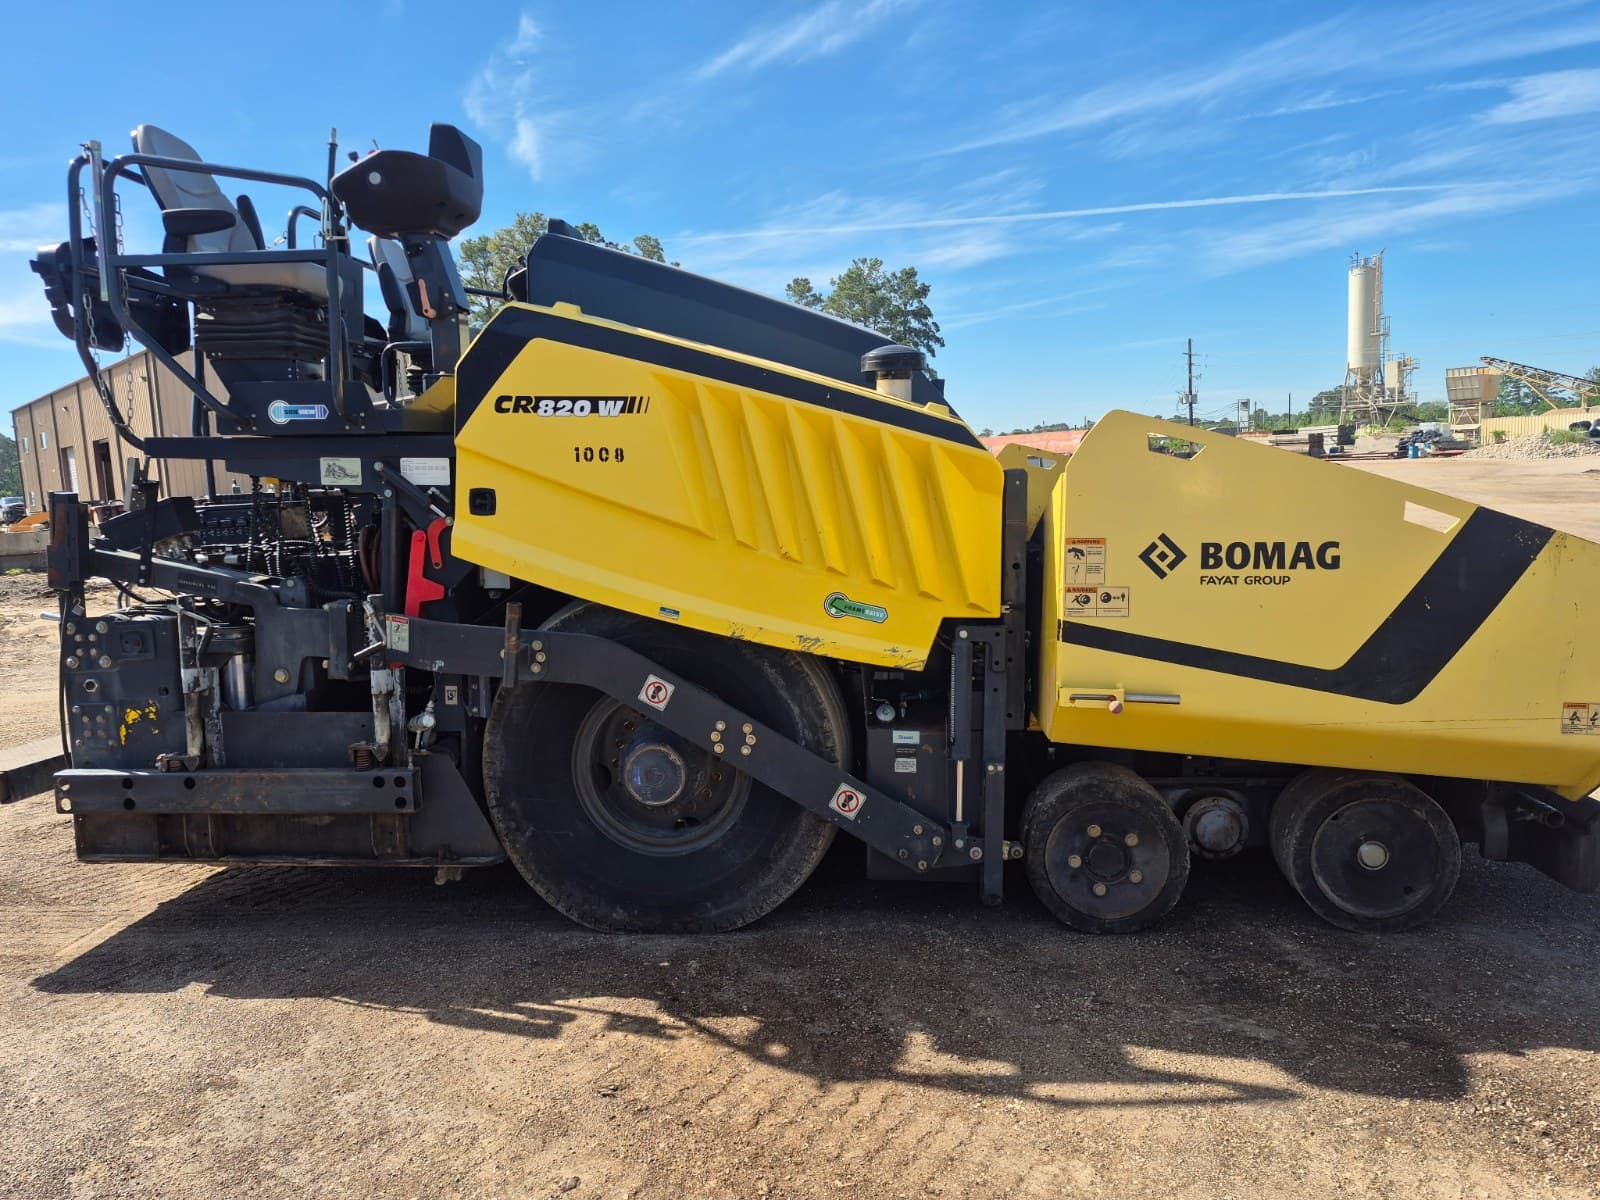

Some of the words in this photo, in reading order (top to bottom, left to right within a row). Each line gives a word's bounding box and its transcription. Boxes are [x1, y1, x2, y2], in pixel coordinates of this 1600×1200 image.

[574, 446, 625, 463] 1008
[1200, 541, 1341, 570] BOMAG
[1199, 575, 1240, 585] FAYAT
[1244, 575, 1291, 585] GROUP
